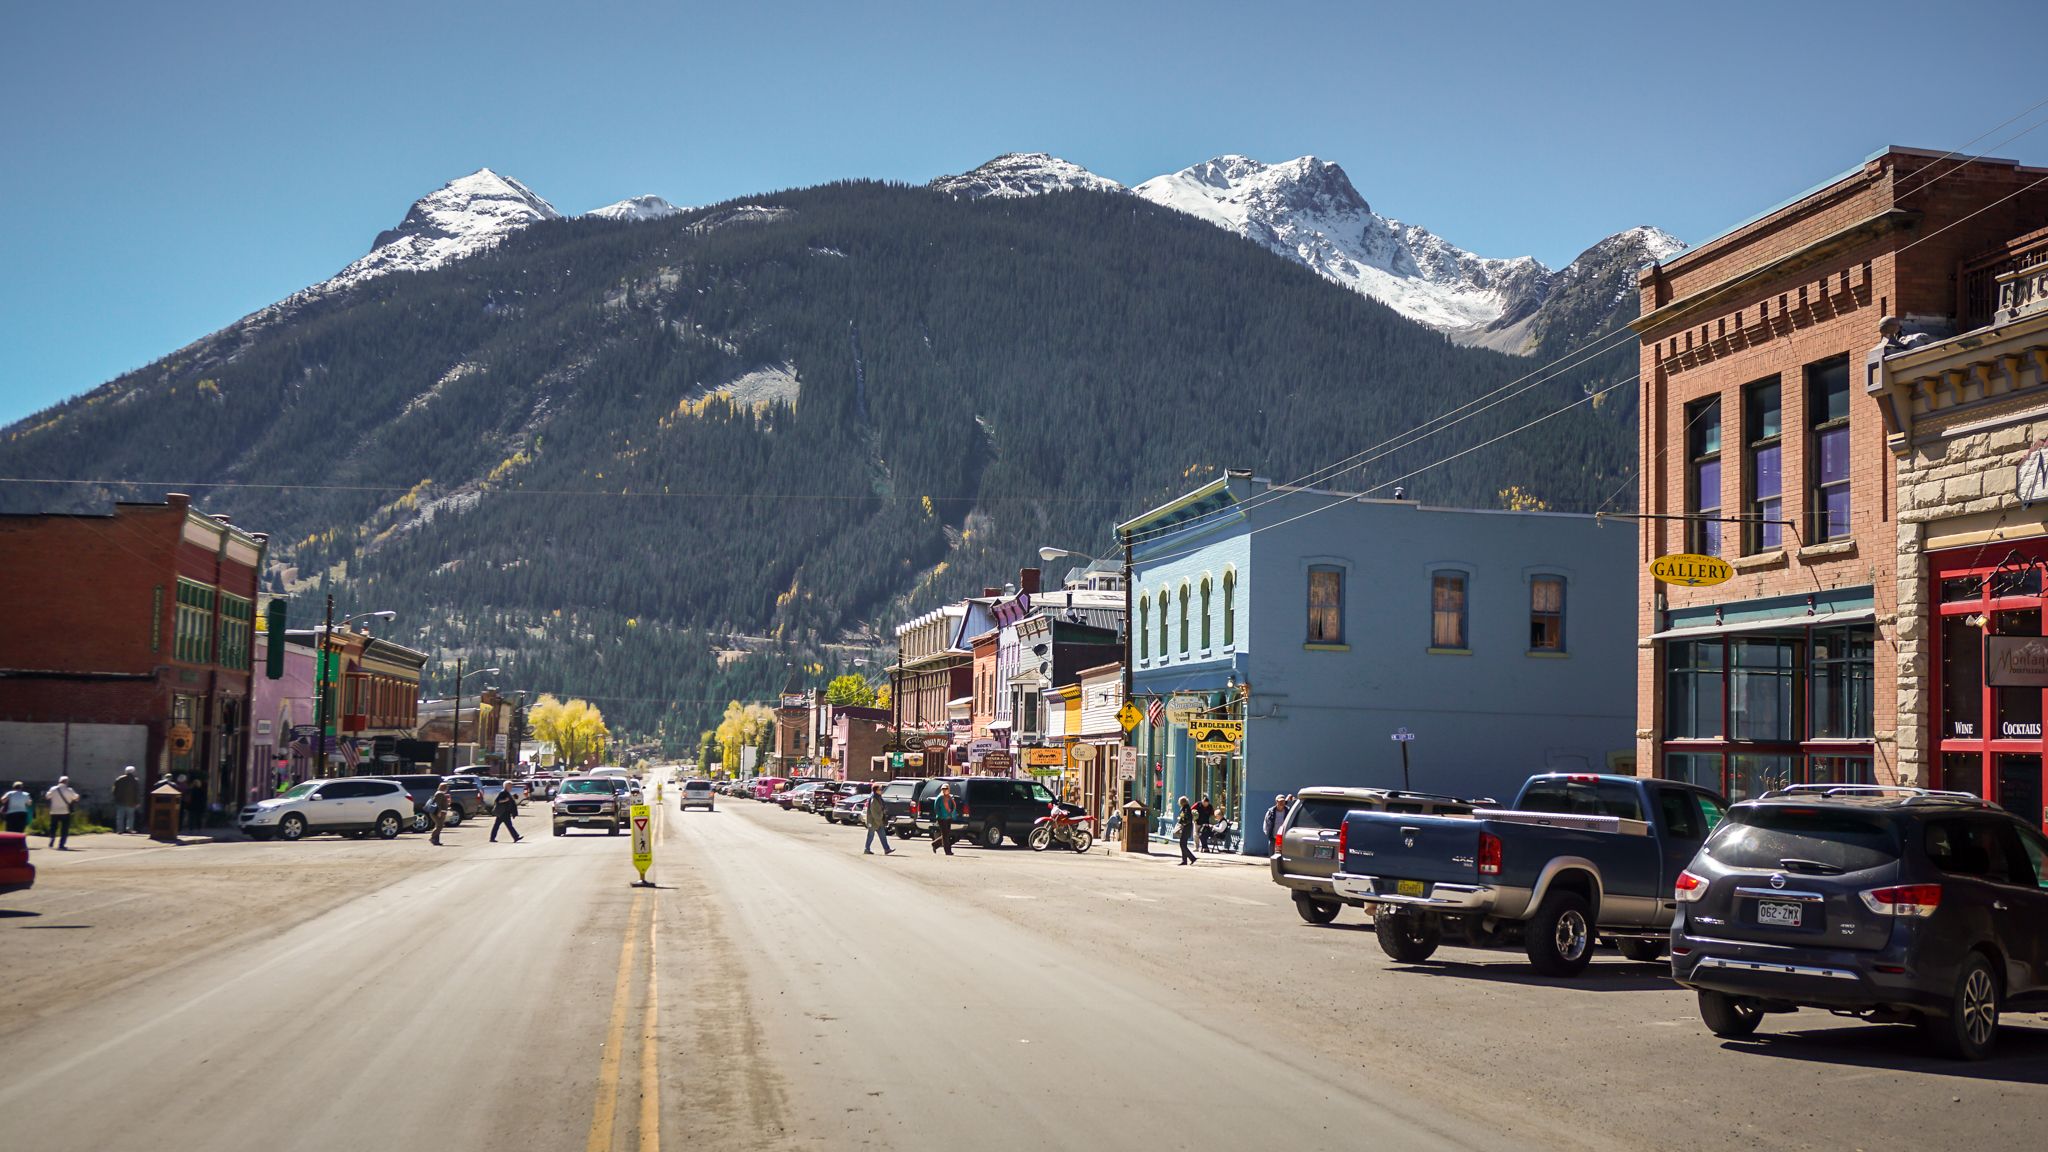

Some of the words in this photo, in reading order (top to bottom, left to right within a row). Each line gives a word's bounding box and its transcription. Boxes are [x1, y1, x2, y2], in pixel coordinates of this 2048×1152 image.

[1654, 562, 1729, 578] GALLERY
[1190, 721, 1242, 731] HANDLEBARS
[1954, 721, 1974, 735] WINE
[2002, 721, 2041, 735] COCKTAILS
